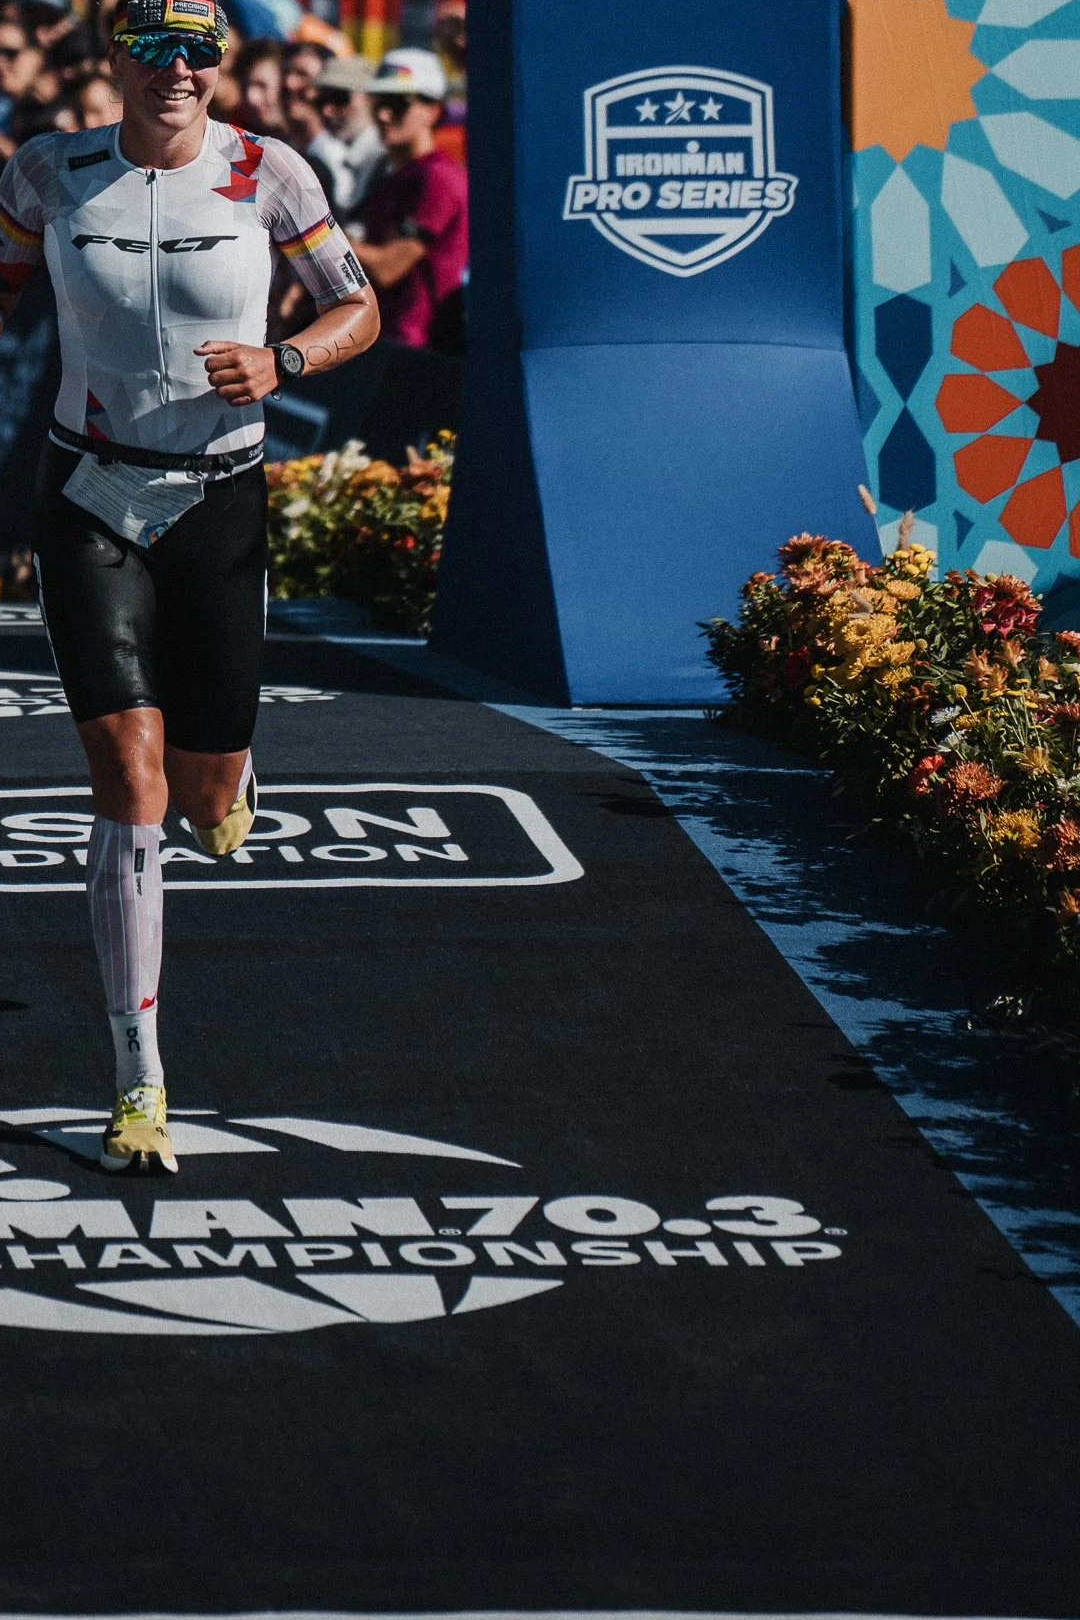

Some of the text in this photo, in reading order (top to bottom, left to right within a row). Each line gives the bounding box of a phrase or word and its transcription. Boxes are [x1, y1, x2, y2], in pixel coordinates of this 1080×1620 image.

[174, 1, 208, 12] PRECISION
[616, 148, 745, 177] IRONMAN
[572, 179, 789, 211] PRO SERIES
[71, 233, 239, 255] FELT
[440, 1194, 823, 1237] 70.3
